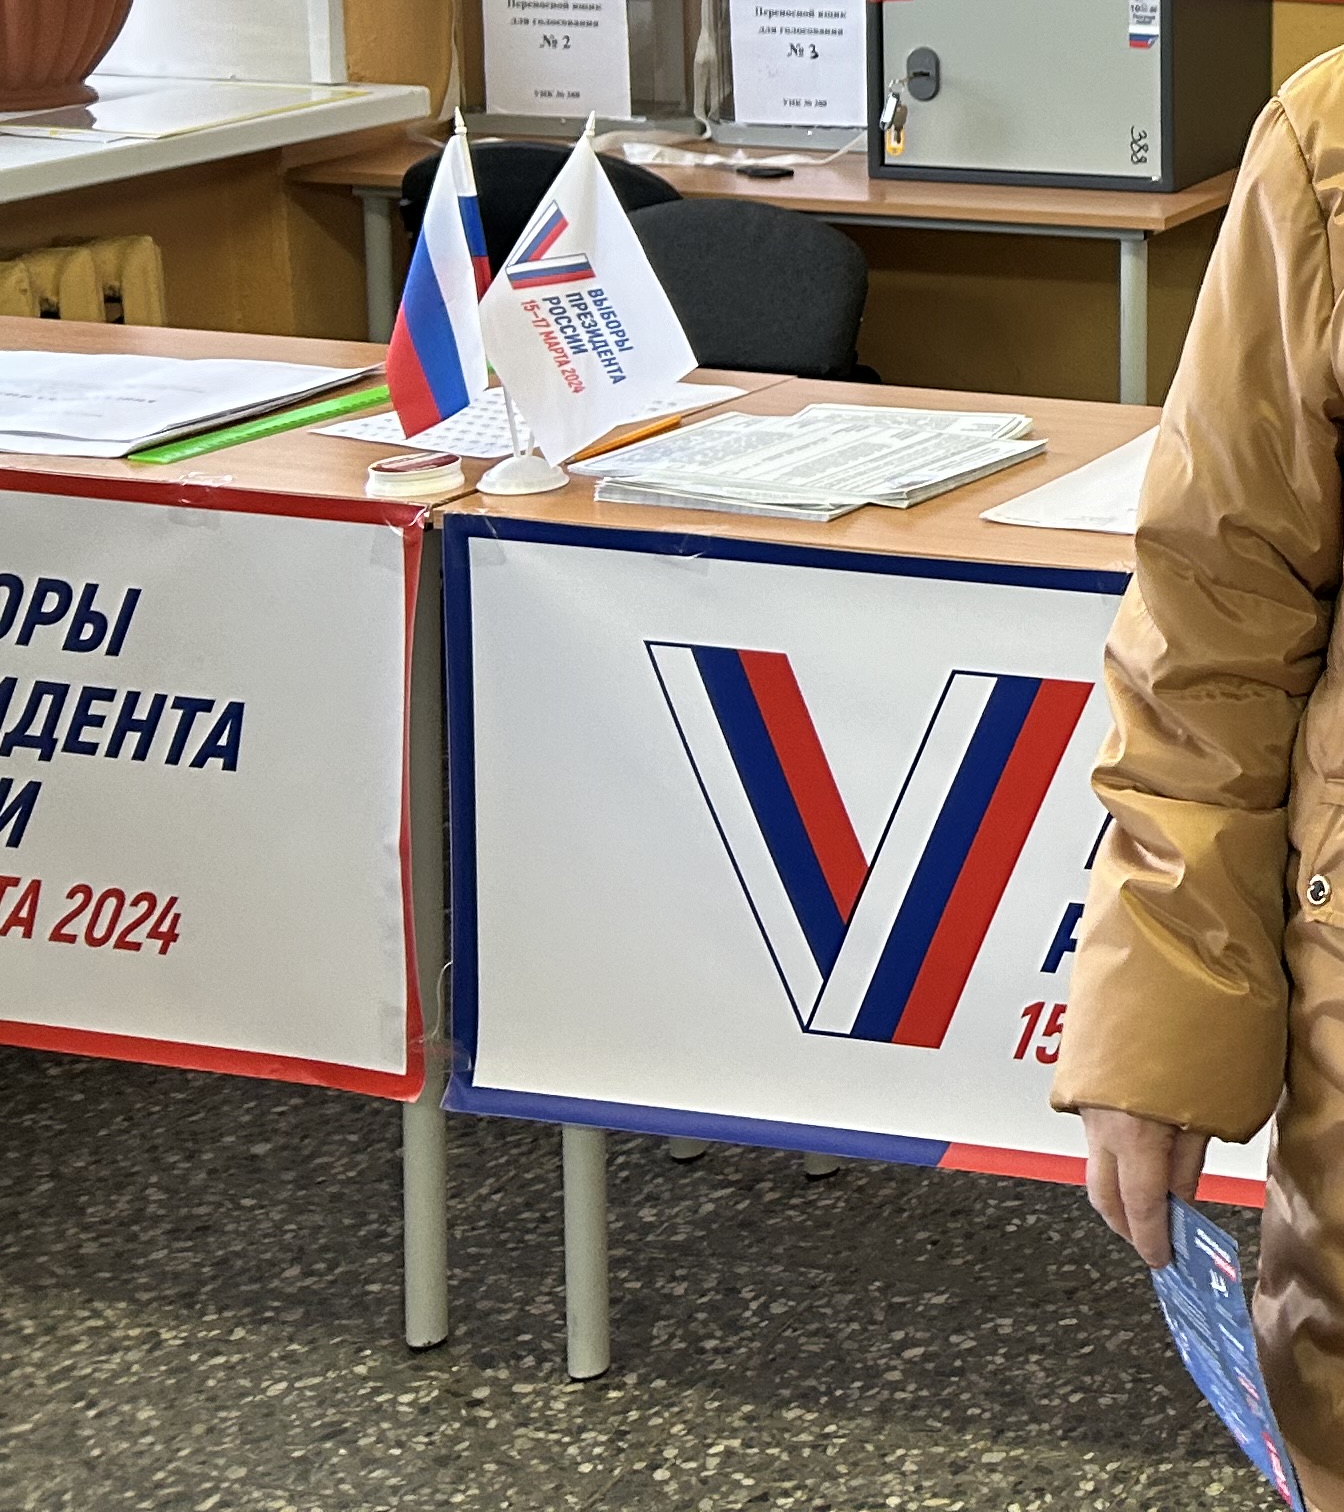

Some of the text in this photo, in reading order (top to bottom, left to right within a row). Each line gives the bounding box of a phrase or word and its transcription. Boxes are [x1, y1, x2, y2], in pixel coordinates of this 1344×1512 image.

[539, 34, 571, 49] № 2
[787, 43, 819, 59] № 3
[541, 296, 588, 355] РОССИИ
[565, 291, 627, 384] ПРЕЗИДЕНТА
[587, 288, 634, 352] ВЫБОРЫ
[539, 330, 572, 368] МАРТА
[561, 367, 586, 393] 2024
[49, 882, 182, 956] 2024
